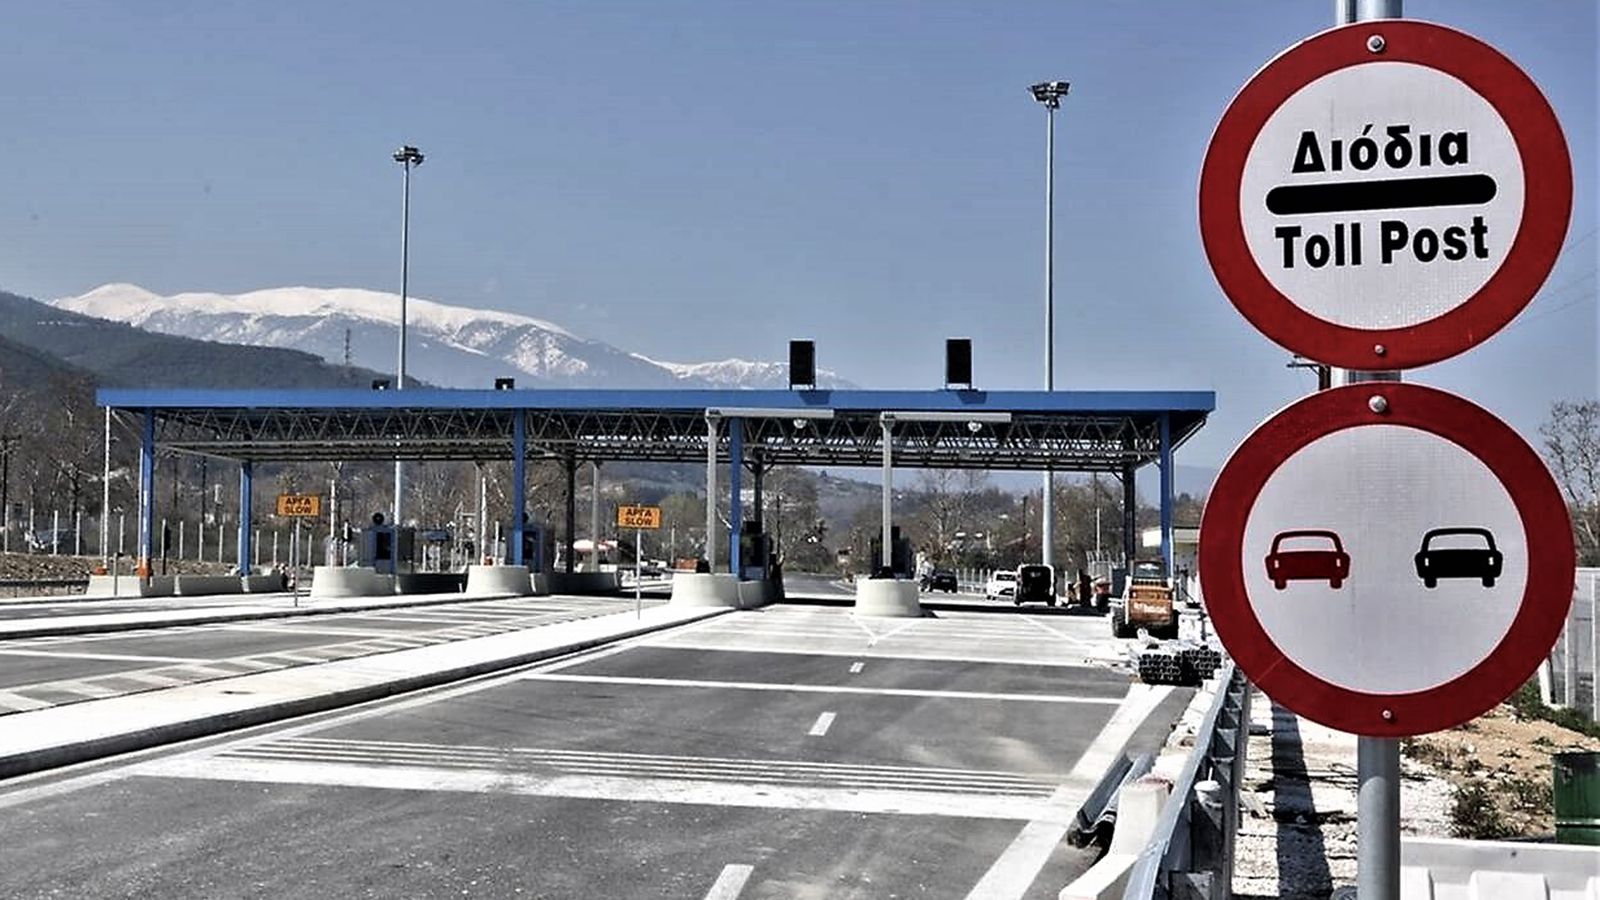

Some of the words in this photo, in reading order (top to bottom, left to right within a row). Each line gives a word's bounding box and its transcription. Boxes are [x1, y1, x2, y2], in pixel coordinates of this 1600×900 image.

[1291, 123, 1469, 174] Διόδια
[1275, 222, 1362, 268] Toll
[1380, 216, 1489, 264] Post
[625, 517, 652, 526] SLOW
